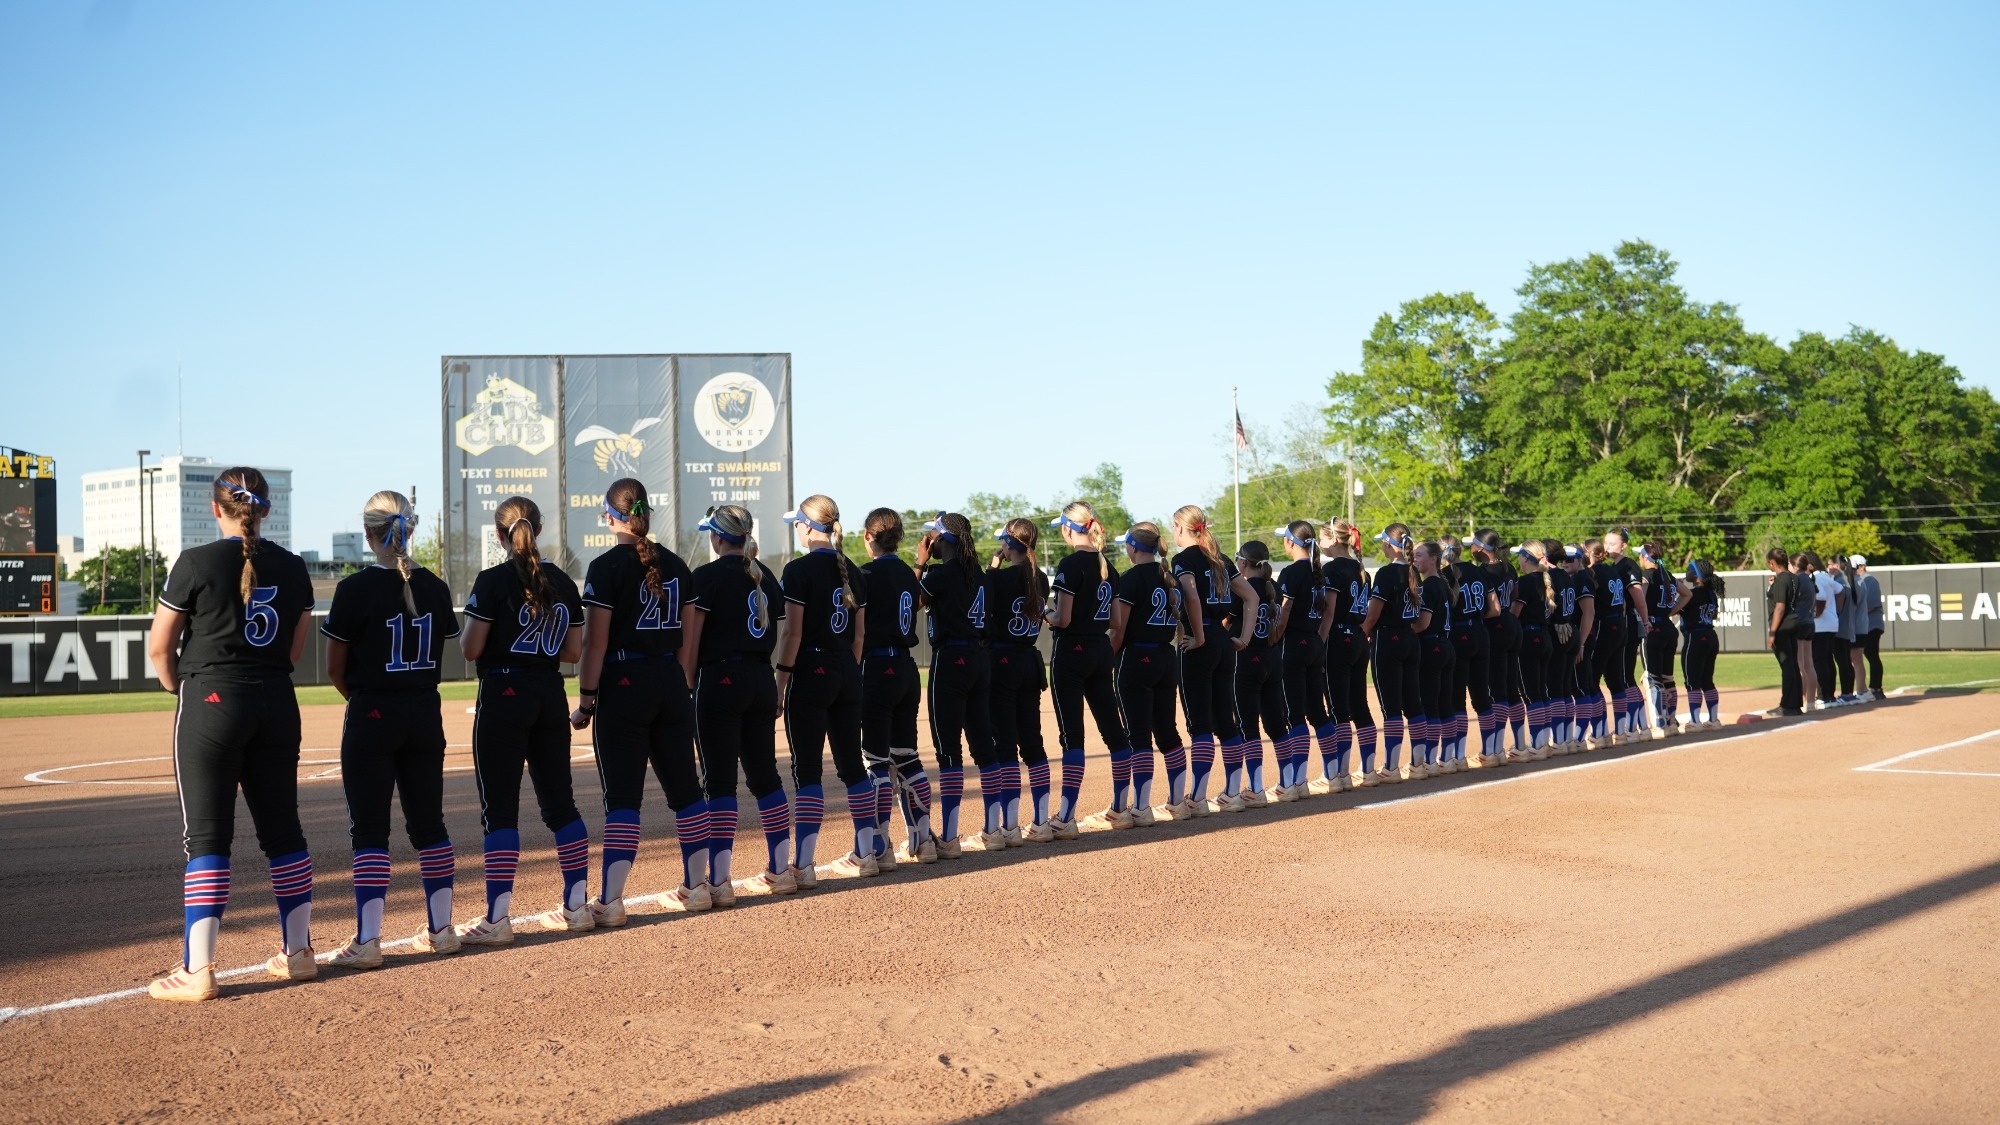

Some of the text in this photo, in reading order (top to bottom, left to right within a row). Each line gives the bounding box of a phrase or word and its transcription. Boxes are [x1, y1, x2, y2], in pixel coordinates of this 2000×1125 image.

[465, 423, 546, 446] CLUB
[705, 429, 764, 437] HORNET
[717, 439, 753, 447] CLUB
[460, 467, 548, 479] TEXT STINGER
[685, 463, 714, 473] TEXT
[476, 483, 533, 494] TO 41444
[709, 476, 761, 487] TO 71777
[570, 494, 604, 507] BAM
[711, 490, 760, 501] TO JOIN!
[481, 500, 498, 511] TO
[0, 560, 24, 569] TTER
[31, 574, 52, 582] RUNS
[42, 582, 51, 596] 0
[636, 577, 682, 630] 21
[1093, 581, 1112, 620] 2
[1349, 580, 1369, 615] 24
[1723, 597, 1751, 612] WAIT
[42, 597, 51, 613] 0
[967, 585, 986, 629] 4
[1971, 592, 2000, 620] A
[244, 585, 279, 647] 5
[899, 590, 913, 636] 6
[510, 602, 570, 656] 20
[385, 612, 436, 671] 11
